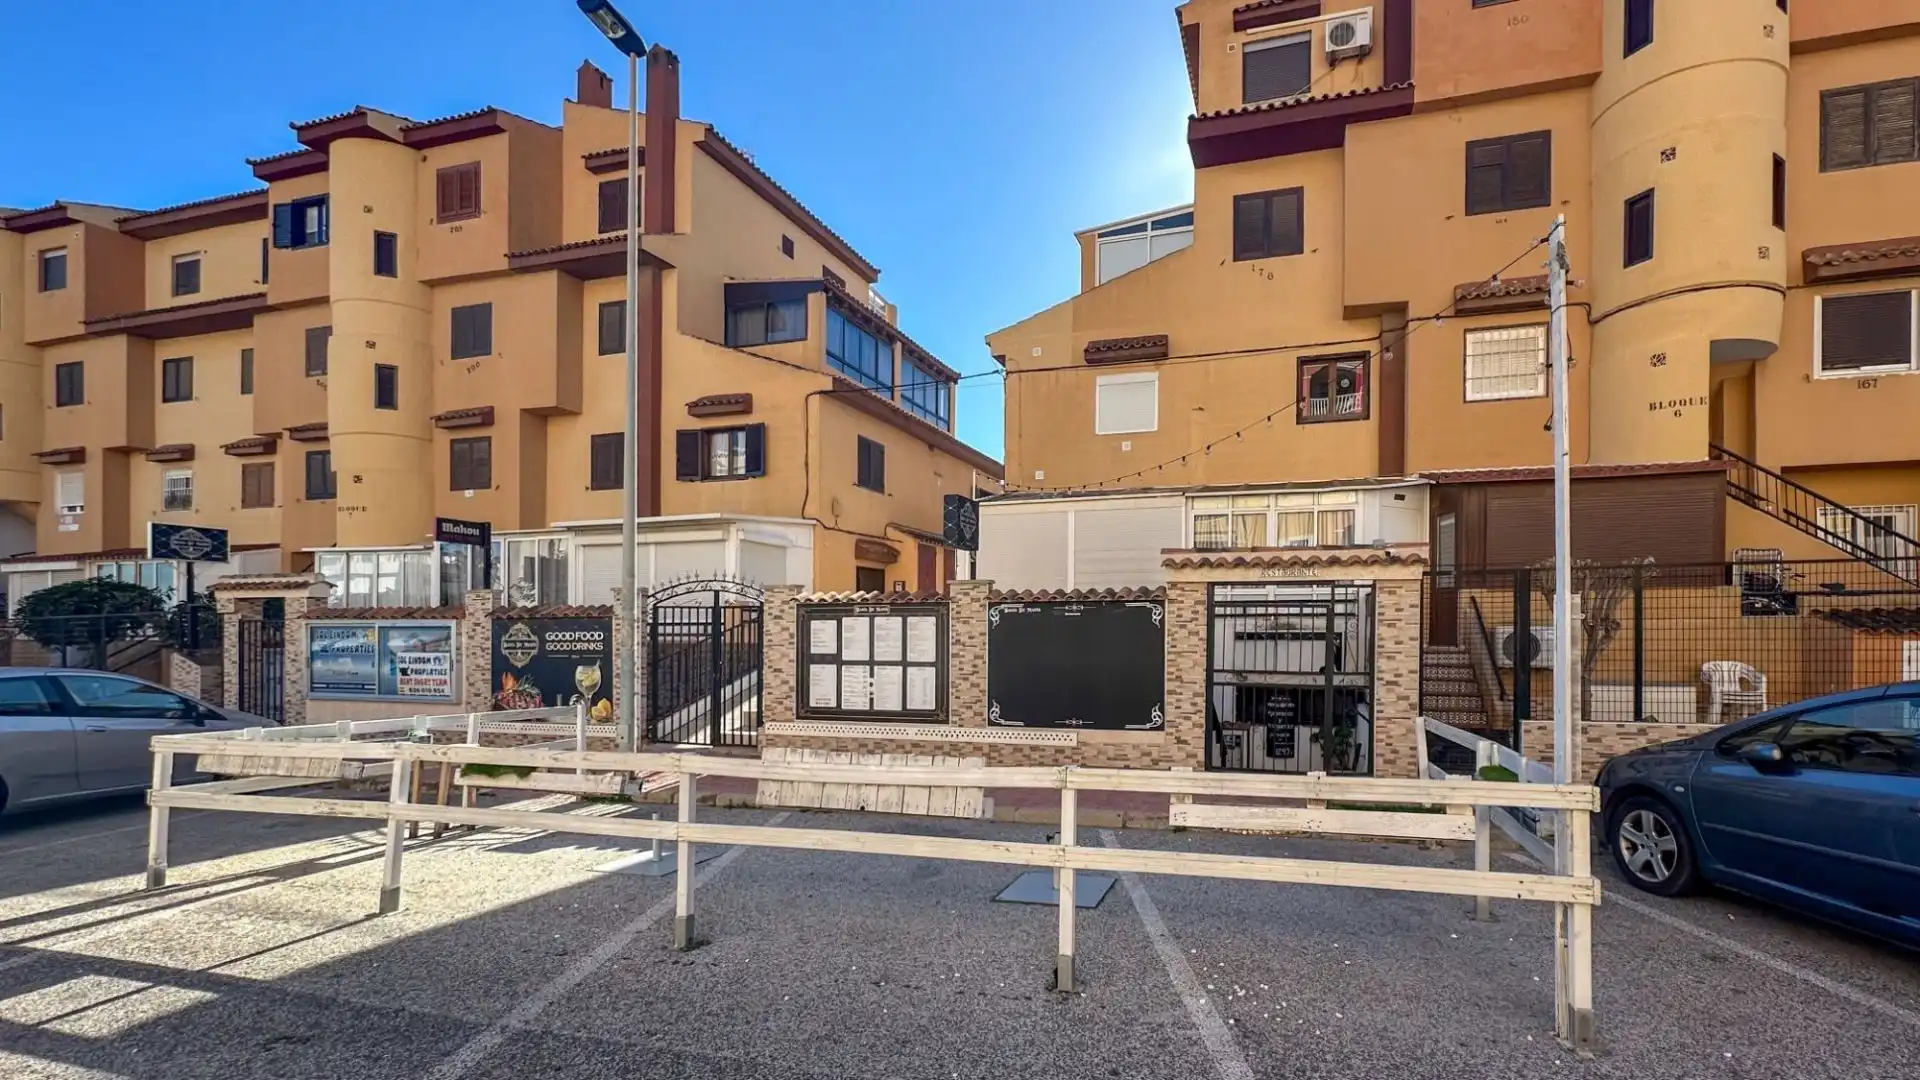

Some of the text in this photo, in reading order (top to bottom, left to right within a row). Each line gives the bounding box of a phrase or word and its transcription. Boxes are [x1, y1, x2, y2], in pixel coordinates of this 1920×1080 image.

[1857, 378, 1878, 389] 167
[1648, 396, 1708, 411] BLOQUE
[1673, 409, 1682, 418] 6
[441, 522, 480, 536] Mahou
[545, 631, 604, 641] GOOD FOOD
[545, 642, 571, 651] GOOD
[571, 642, 604, 651] DRINKS
